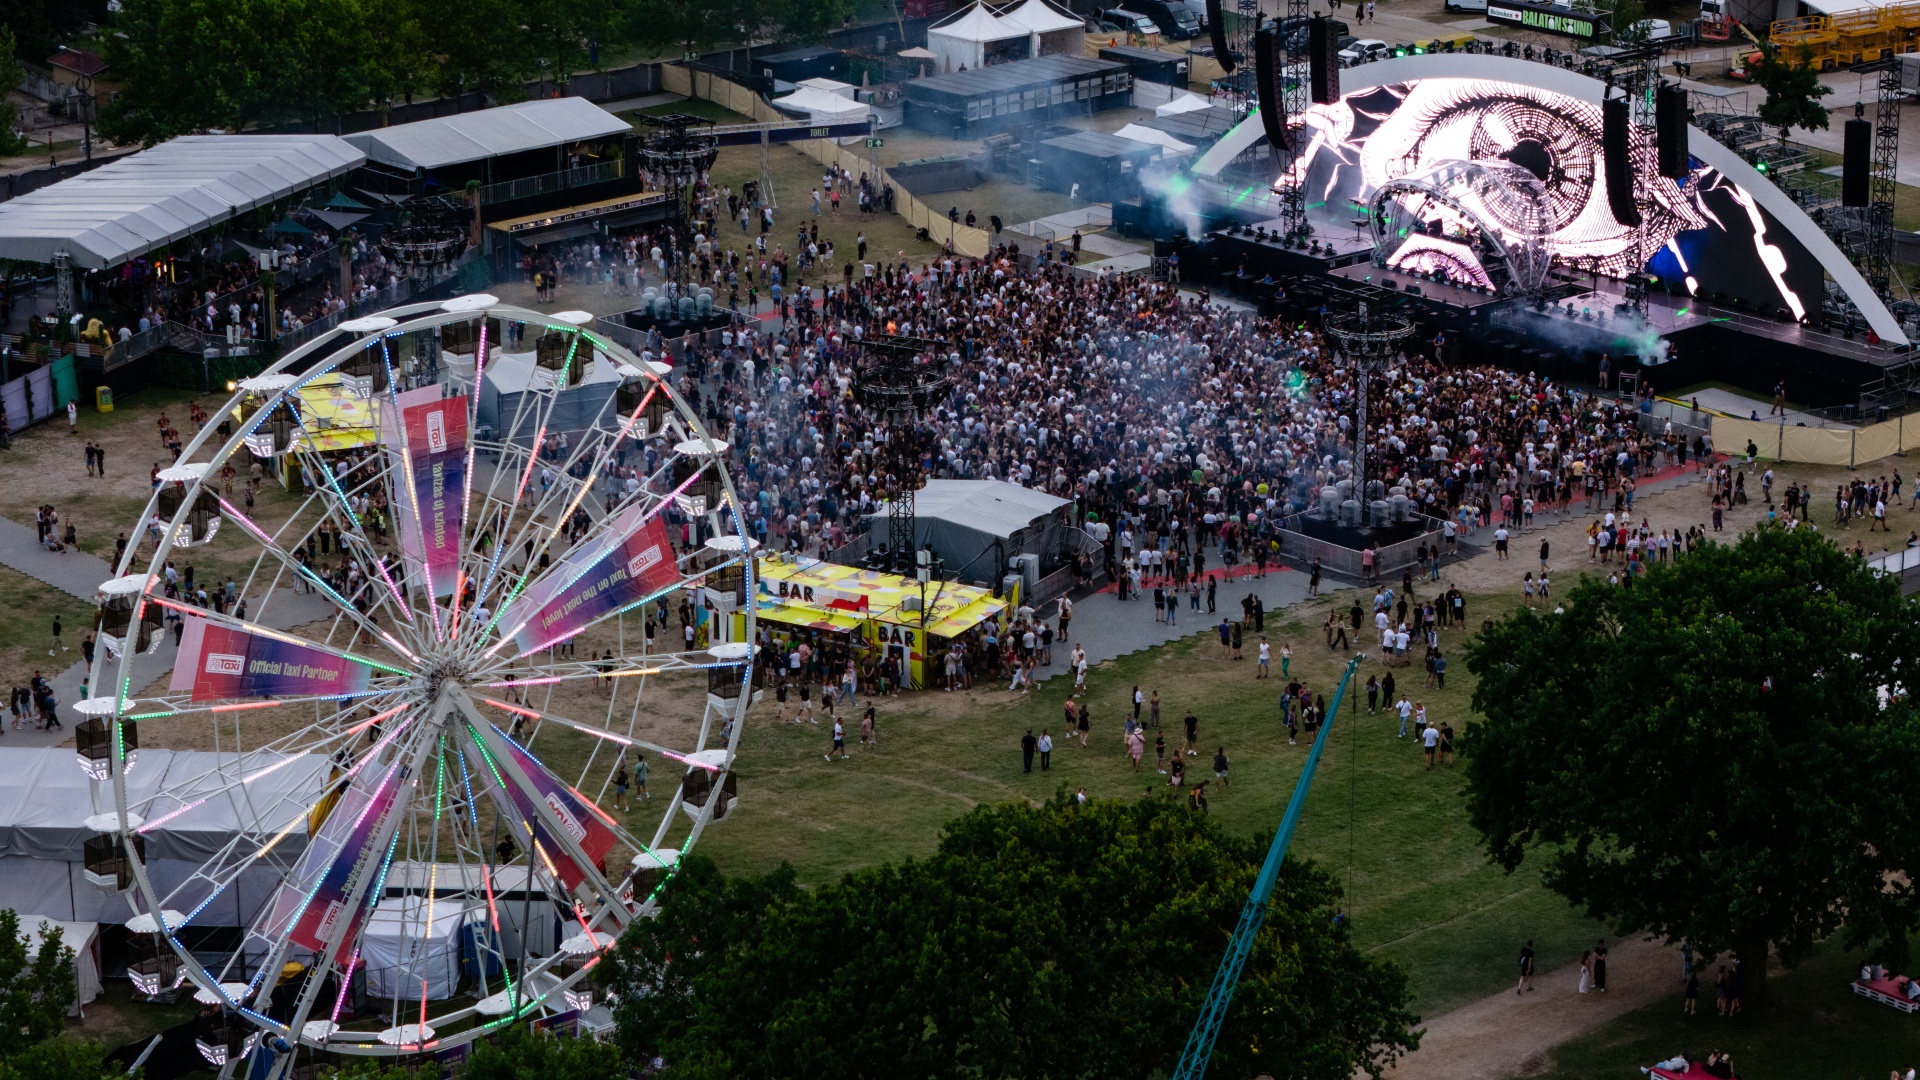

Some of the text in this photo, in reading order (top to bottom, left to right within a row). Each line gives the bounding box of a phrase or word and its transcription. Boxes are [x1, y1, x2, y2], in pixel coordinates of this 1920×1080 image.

[810, 127, 829, 138] TOILET
[432, 461, 444, 498] Taxizás
[434, 512, 446, 549] szinten
[541, 568, 627, 630] Taxi on the next level
[779, 581, 815, 603] BAR
[879, 626, 916, 647] BAR
[250, 659, 339, 682] Official Taxi Partner
